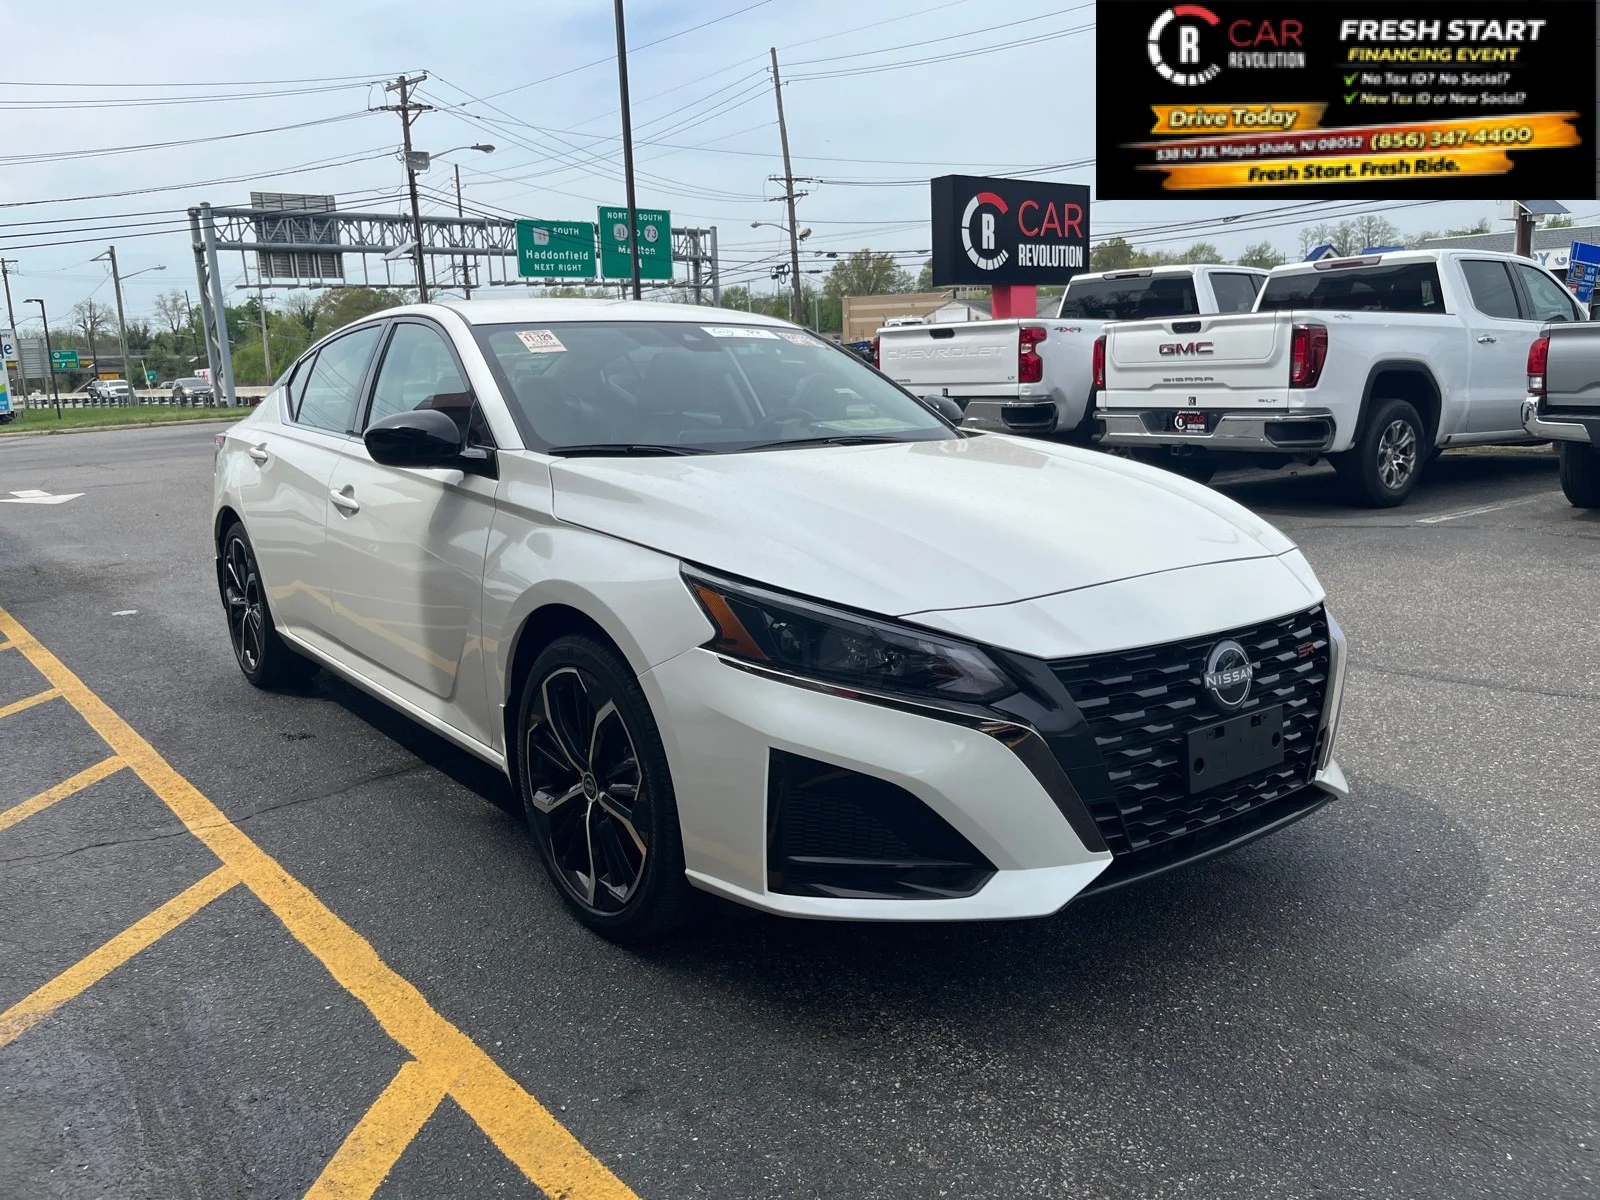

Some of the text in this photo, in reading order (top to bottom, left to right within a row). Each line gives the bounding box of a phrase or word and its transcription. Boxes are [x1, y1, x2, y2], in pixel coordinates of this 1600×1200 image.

[607, 211, 663, 222] NORT SOUTH
[1018, 200, 1083, 239] CAR
[552, 227, 579, 236] SOUTH
[615, 227, 626, 237] 41
[645, 228, 657, 239] 73
[526, 250, 589, 261] Haddonfield
[618, 245, 656, 255] Malton
[1018, 243, 1083, 268] REVOLUTION
[534, 263, 582, 272] NEXT RIGHT
[524, 333, 553, 342] 11-129
[887, 346, 1008, 360] CHEVROLET
[1159, 341, 1214, 356] GMC
[1297, 643, 1316, 658] SR
[1205, 665, 1253, 688] NISSAN
